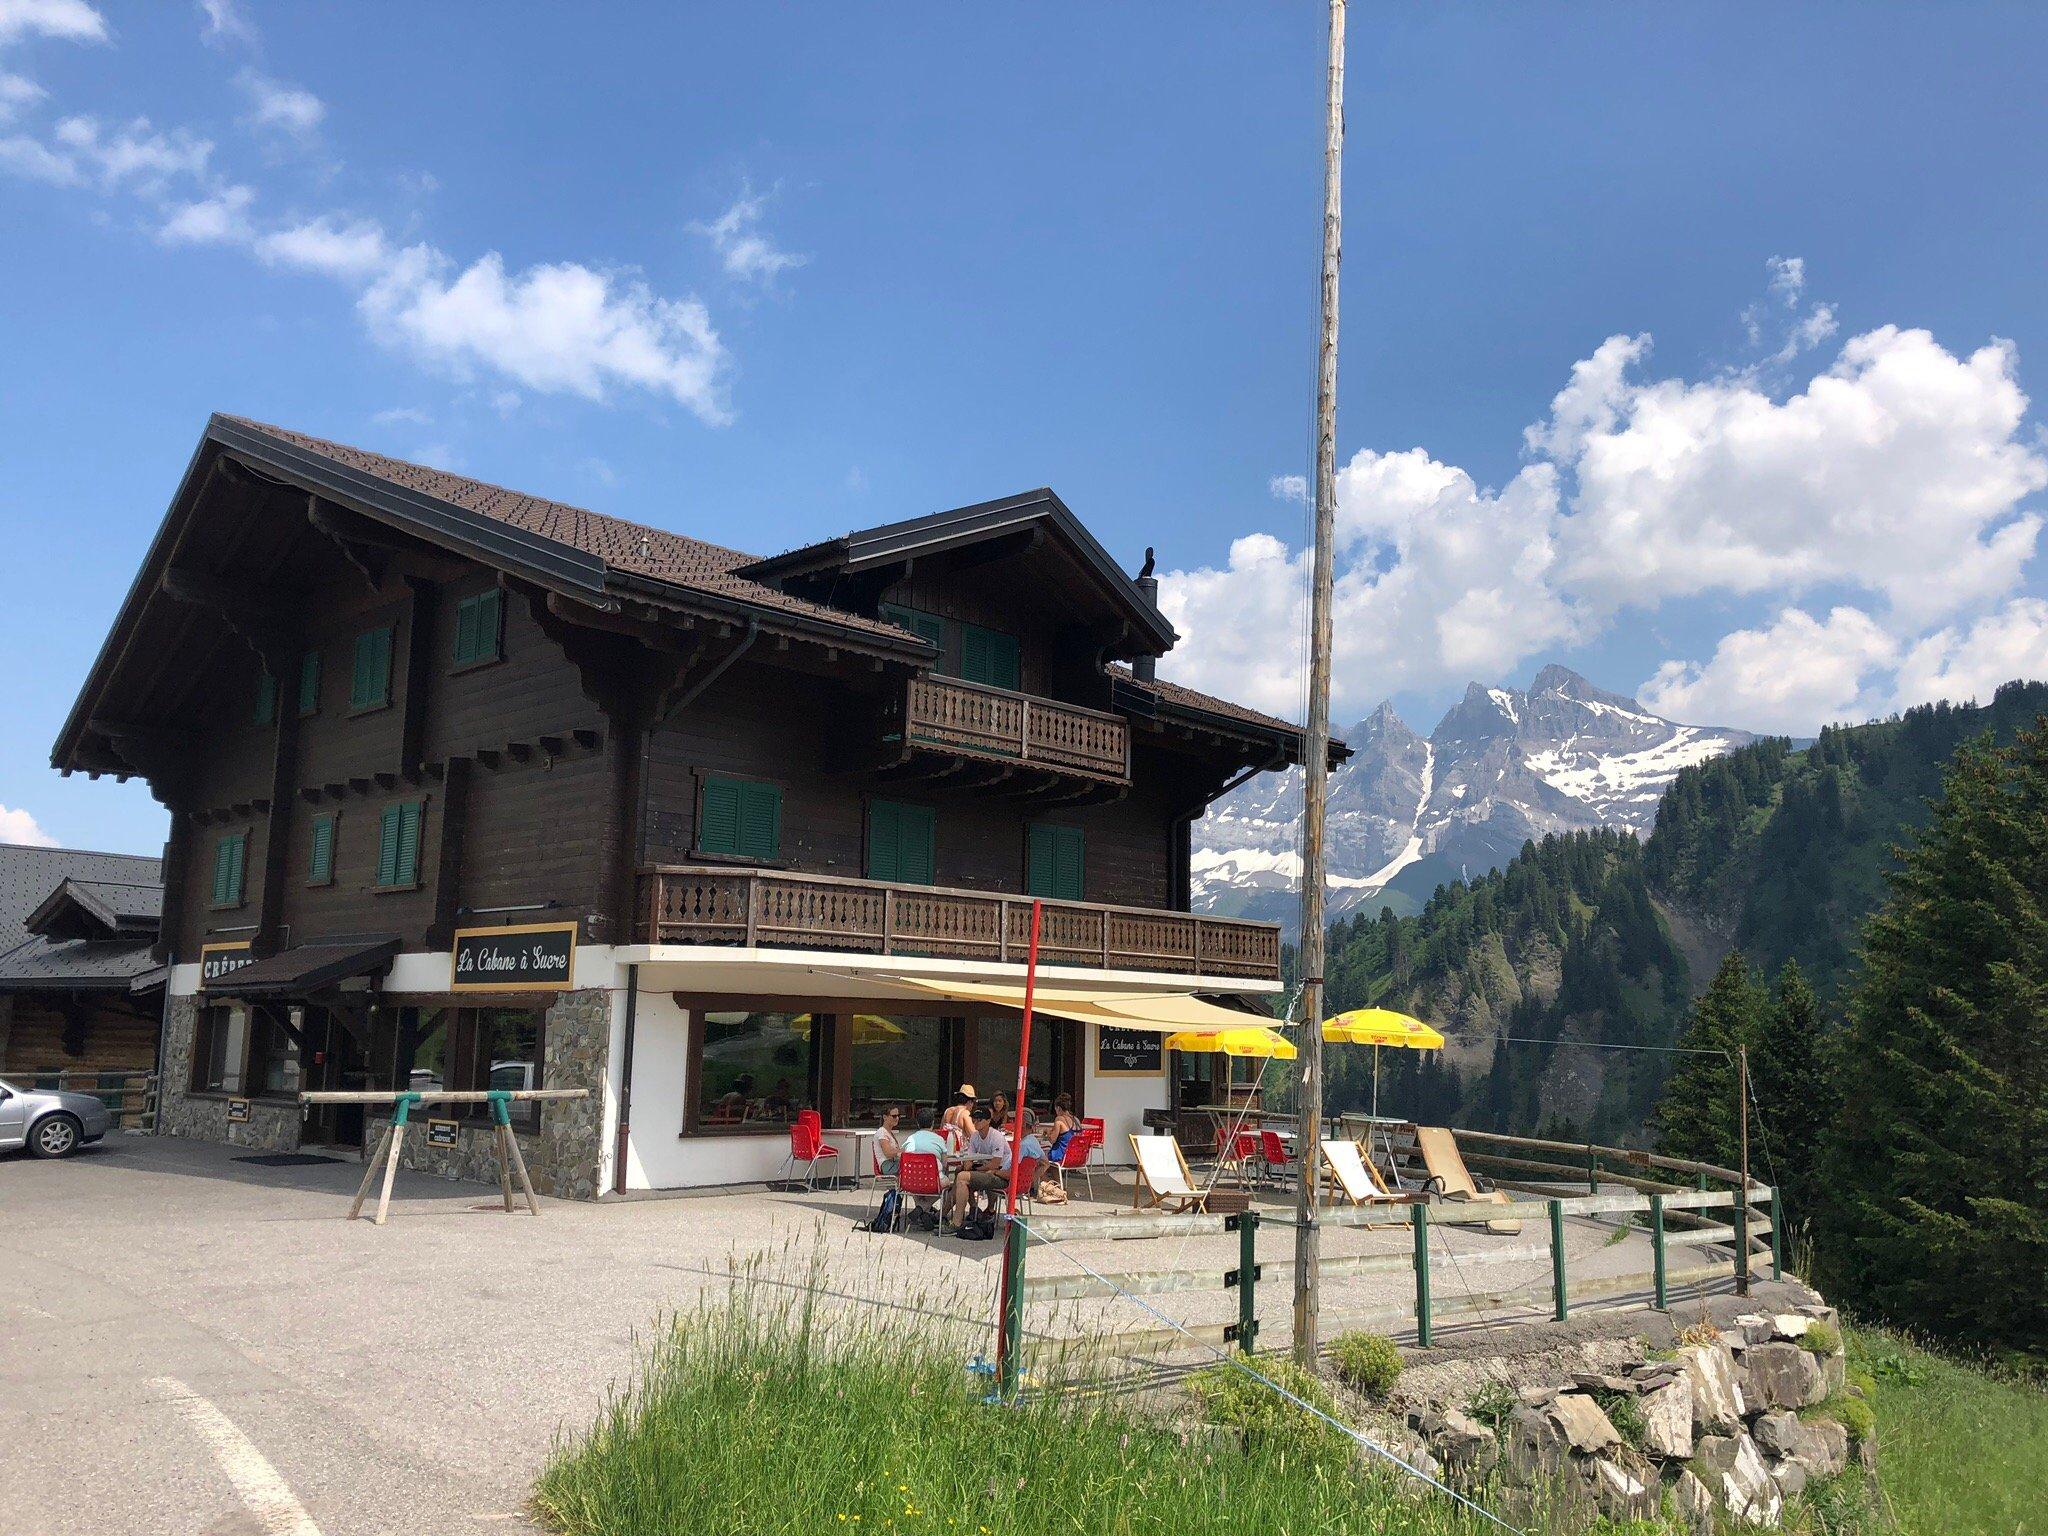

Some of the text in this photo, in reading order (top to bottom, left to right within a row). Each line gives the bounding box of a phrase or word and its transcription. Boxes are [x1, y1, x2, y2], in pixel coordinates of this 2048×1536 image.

[457, 946, 567, 972] La Cabane à Sucre
[1112, 1038, 1135, 1050] Cabane
